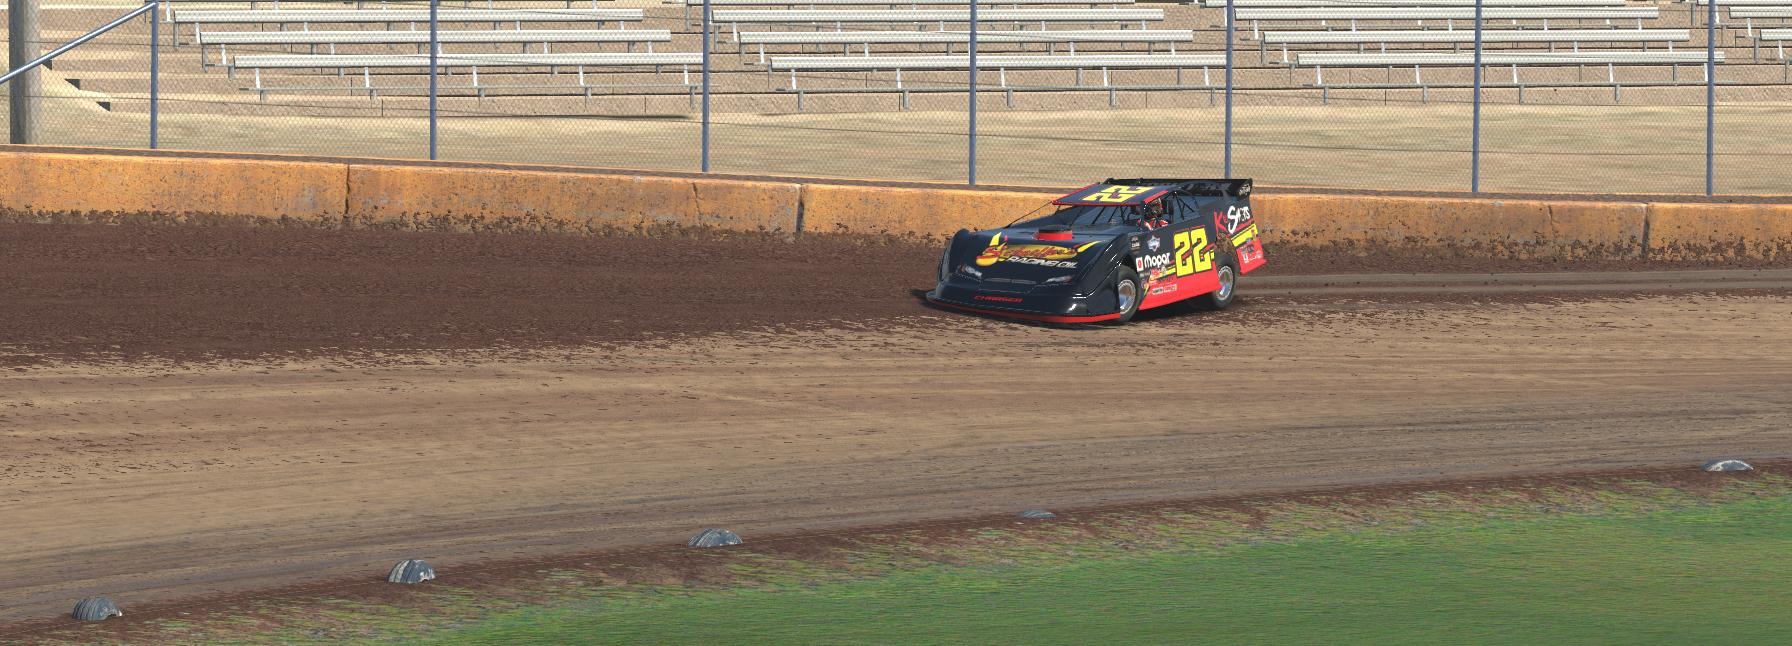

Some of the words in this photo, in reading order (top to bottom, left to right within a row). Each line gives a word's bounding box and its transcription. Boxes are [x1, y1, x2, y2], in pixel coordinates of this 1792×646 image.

[1082, 185, 1153, 203] 22
[1174, 228, 1212, 277] 22
[1007, 256, 1058, 268] RACING
[1057, 261, 1078, 269] OIL
